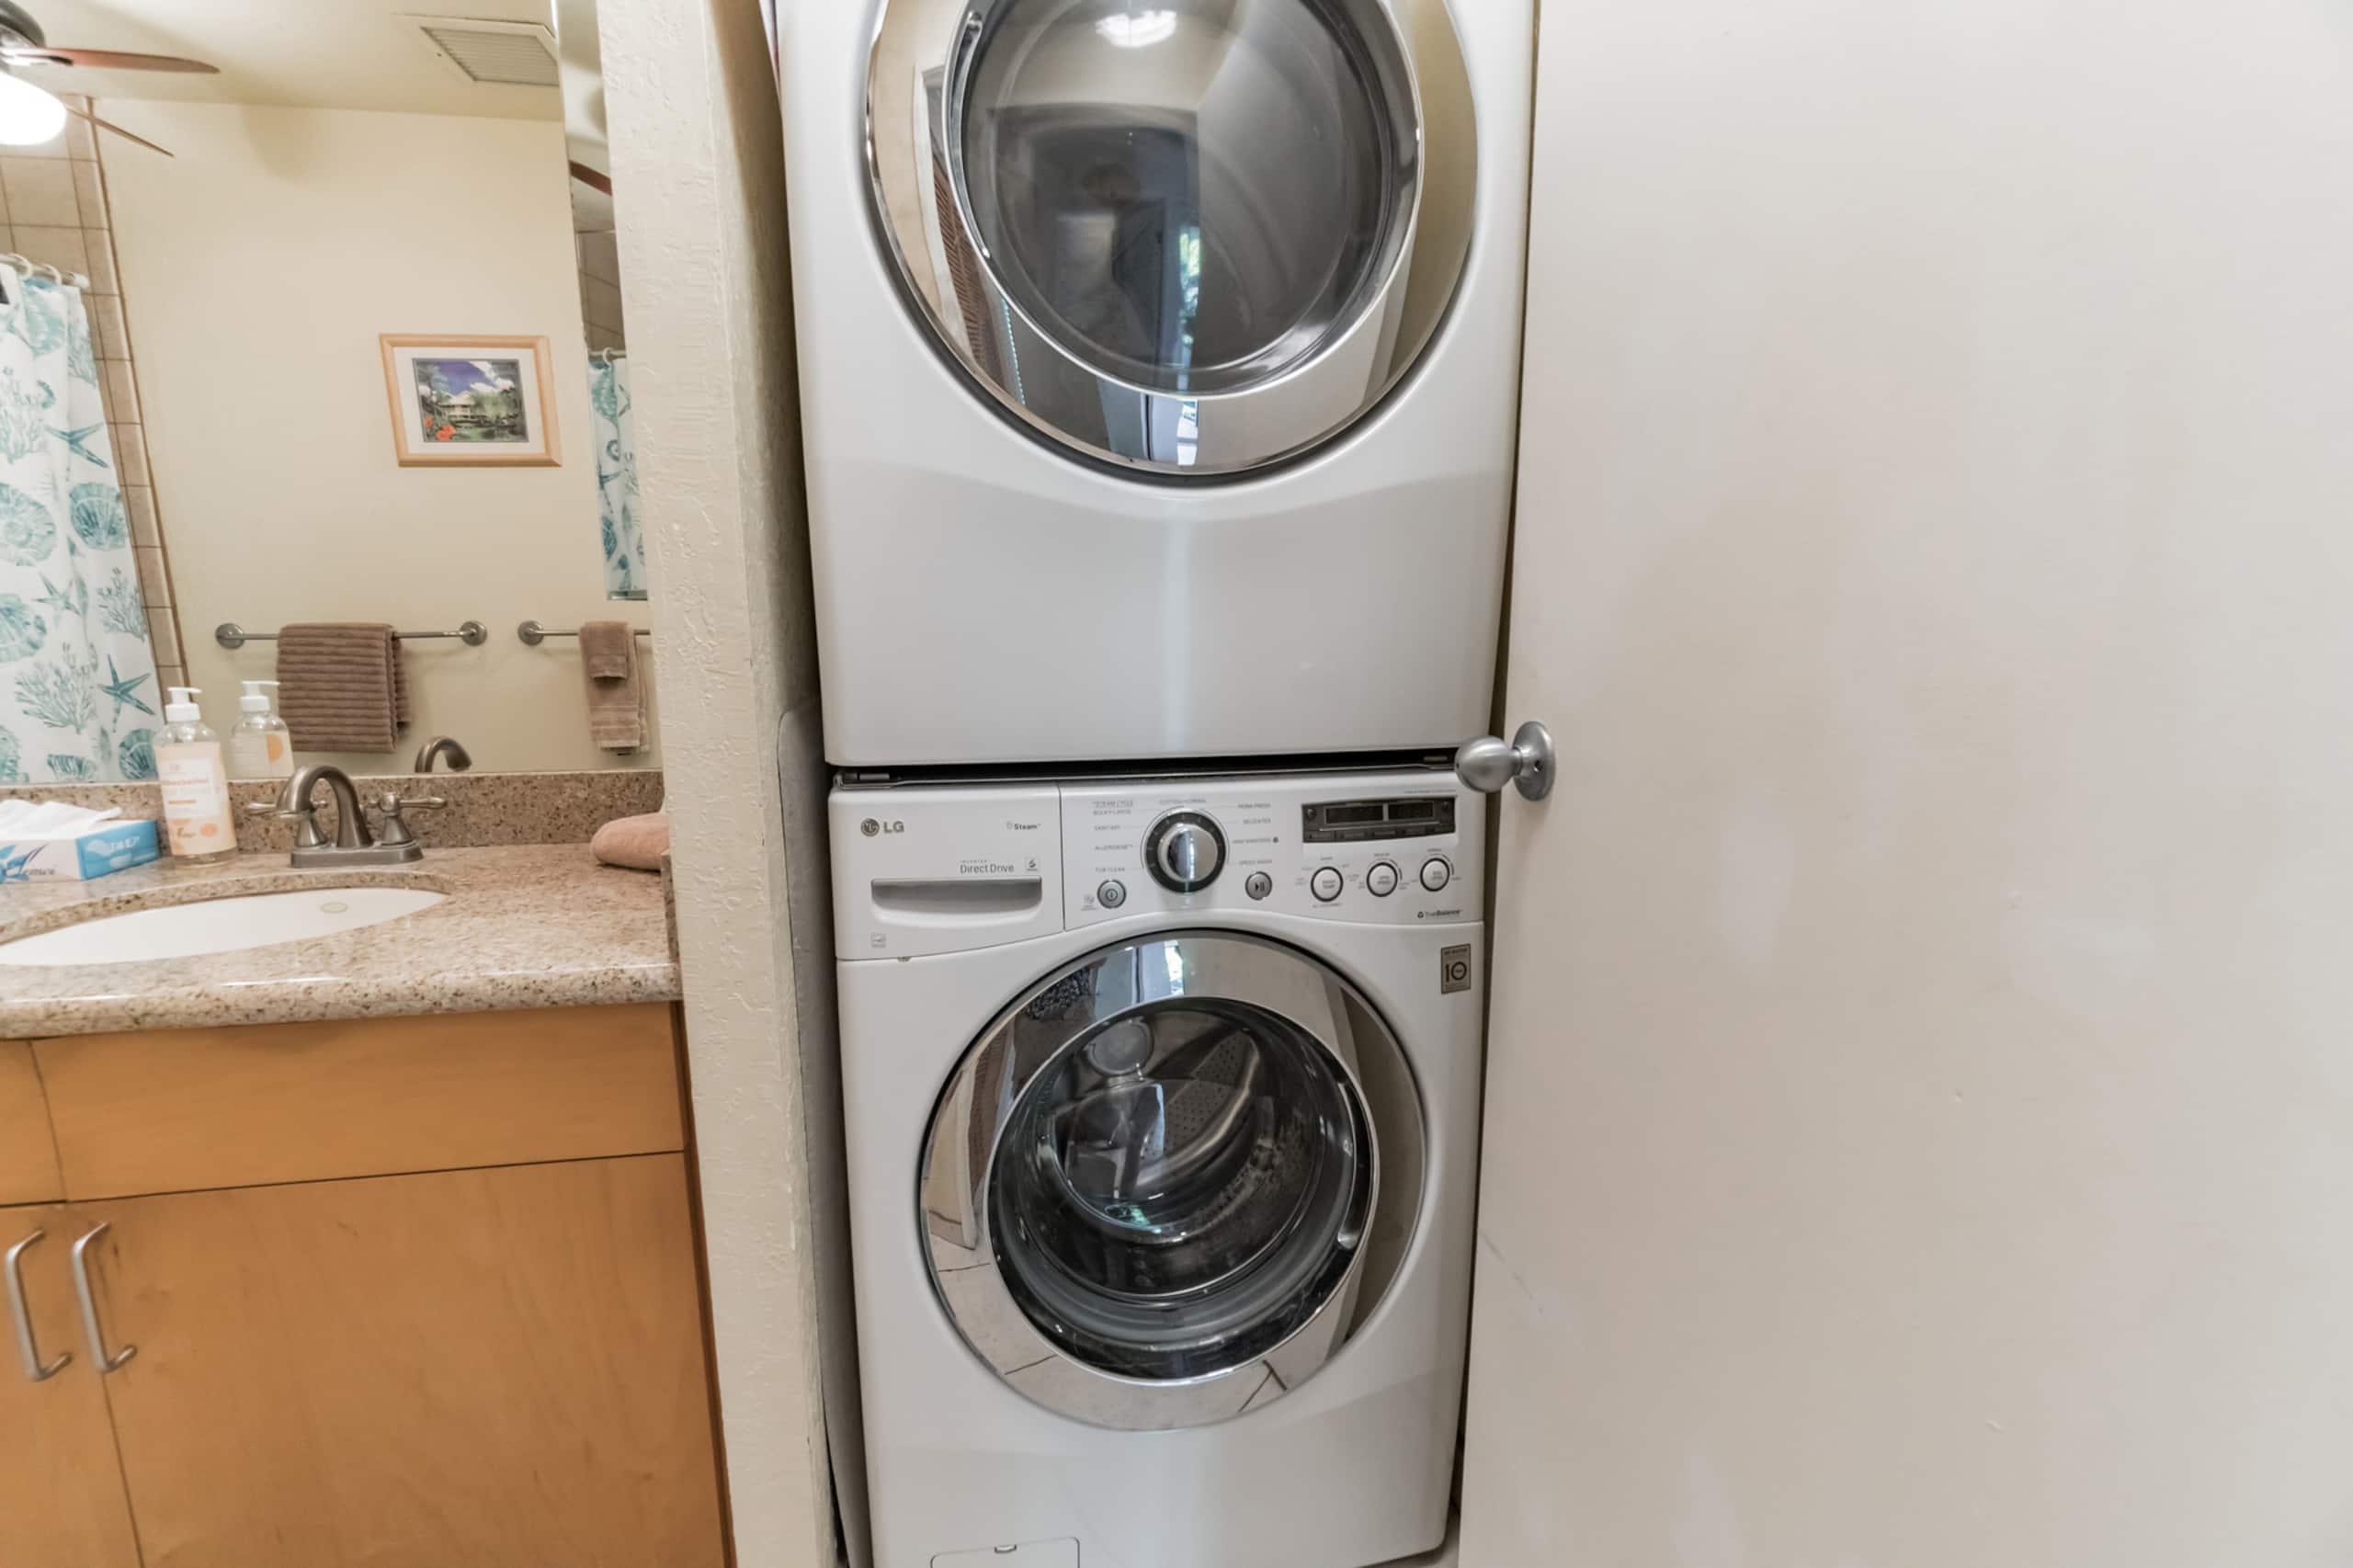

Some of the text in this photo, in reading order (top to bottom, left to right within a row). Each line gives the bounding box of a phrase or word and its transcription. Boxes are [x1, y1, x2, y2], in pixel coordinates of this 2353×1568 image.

[883, 820, 905, 834] LG
[1014, 822, 1038, 831] Steam
[960, 863, 988, 874] Direct
[989, 862, 1015, 873] Drive
